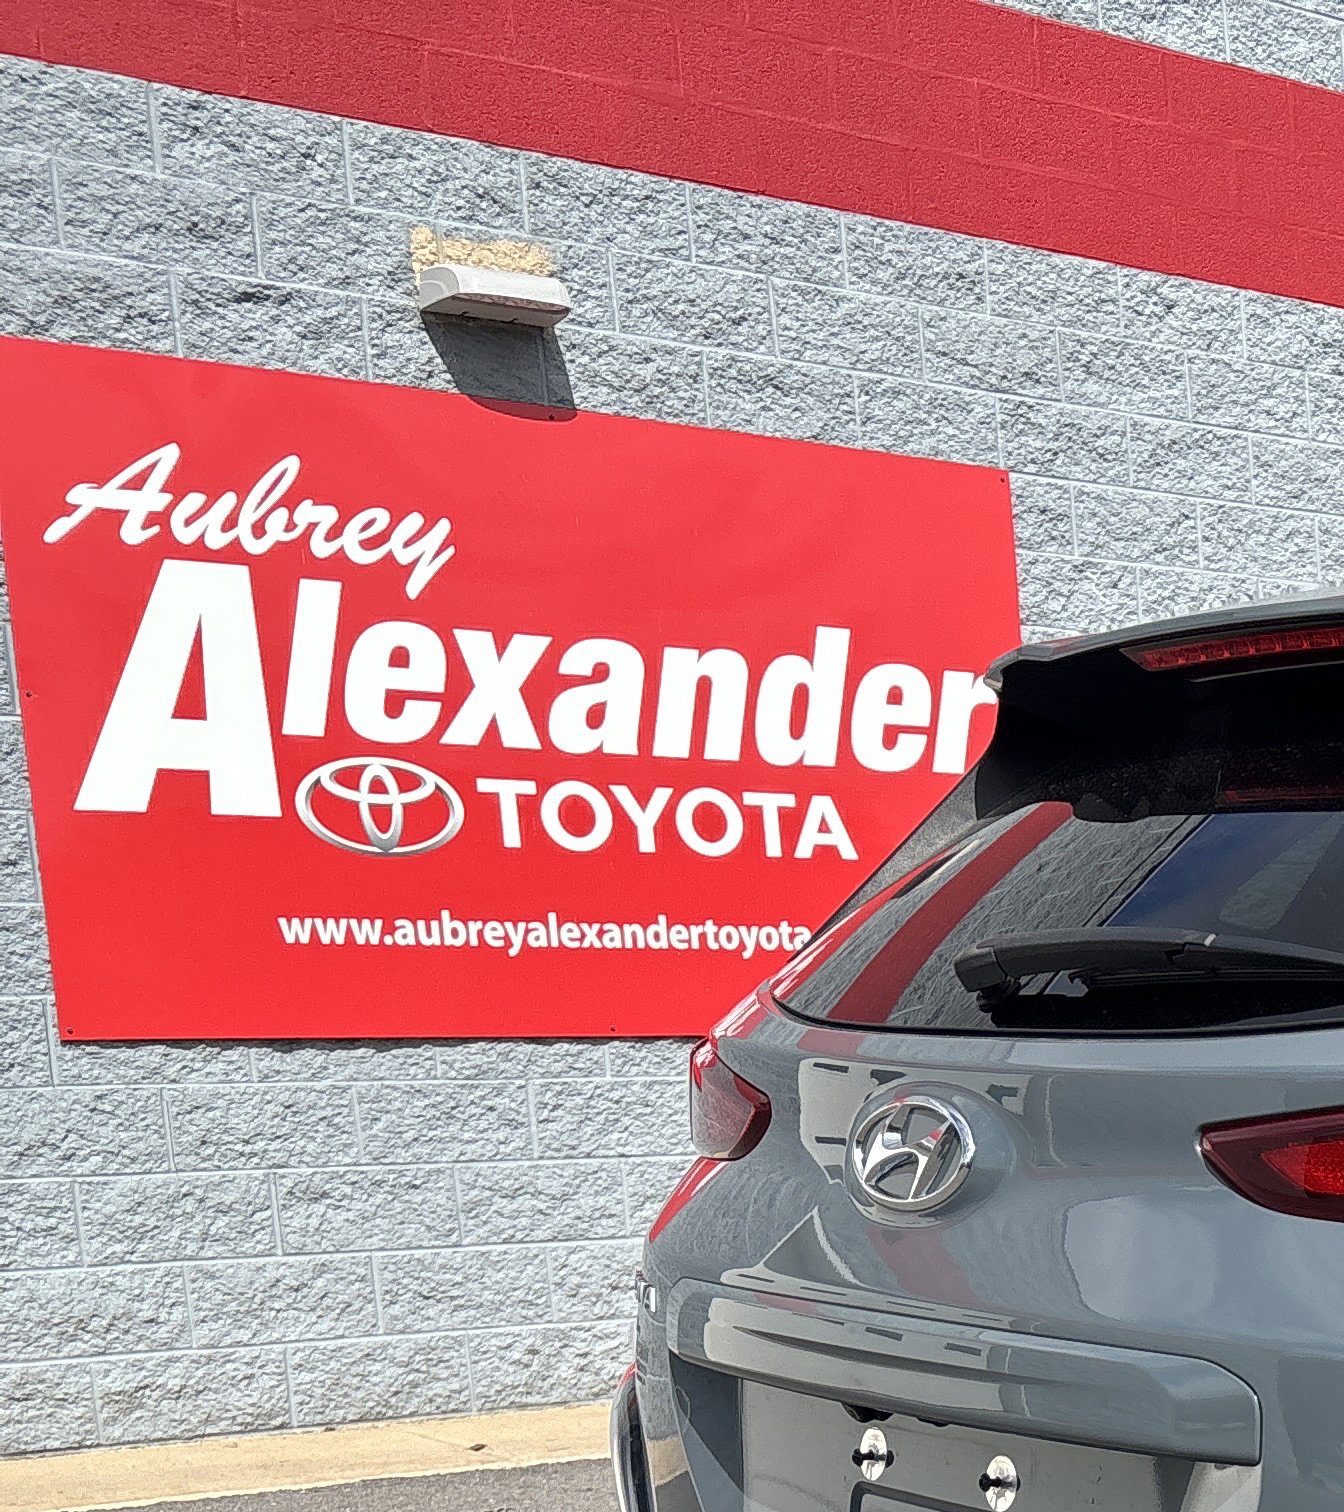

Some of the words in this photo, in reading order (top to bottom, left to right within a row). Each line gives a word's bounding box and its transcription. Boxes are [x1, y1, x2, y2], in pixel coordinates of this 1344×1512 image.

[42, 442, 456, 601] Aubrey
[73, 558, 999, 818] Alexander
[475, 777, 859, 861] TOYOTA
